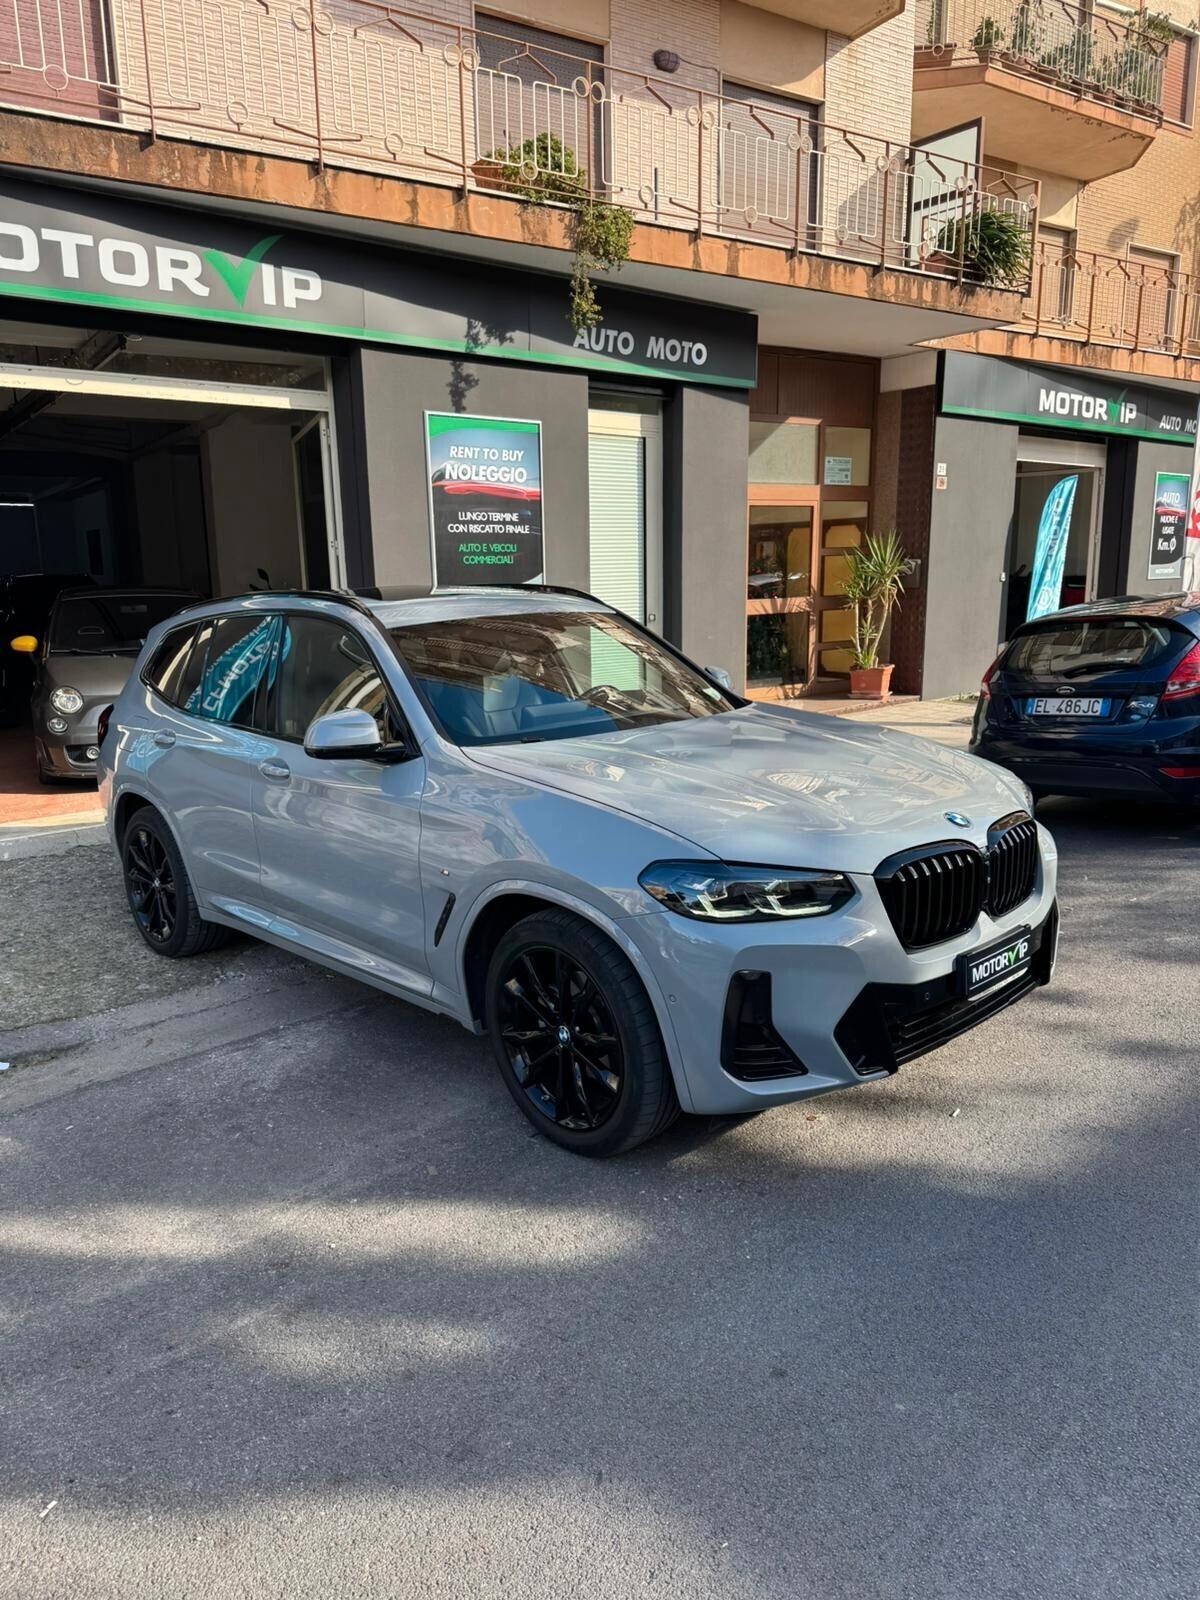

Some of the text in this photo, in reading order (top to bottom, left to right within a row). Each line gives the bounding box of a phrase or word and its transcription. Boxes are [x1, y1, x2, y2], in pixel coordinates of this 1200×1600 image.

[573, 327, 708, 366] AUTO MOTO
[1039, 388, 1137, 424] MOTORVIP
[1159, 414, 1182, 432] AUTO
[449, 445, 525, 462] RENT TO BUY
[445, 463, 528, 484] NOLEGGIO
[1162, 492, 1180, 505] AUTO
[458, 511, 520, 523] LUNGO TERMINE
[447, 523, 531, 535] CON RISCATTO FINALE
[458, 543, 518, 553] AUTO E VEICOLI
[463, 555, 514, 565] COMMERCIALI
[1034, 698, 1100, 715] EL 486JC
[972, 938, 1029, 984] MOTORVIP
